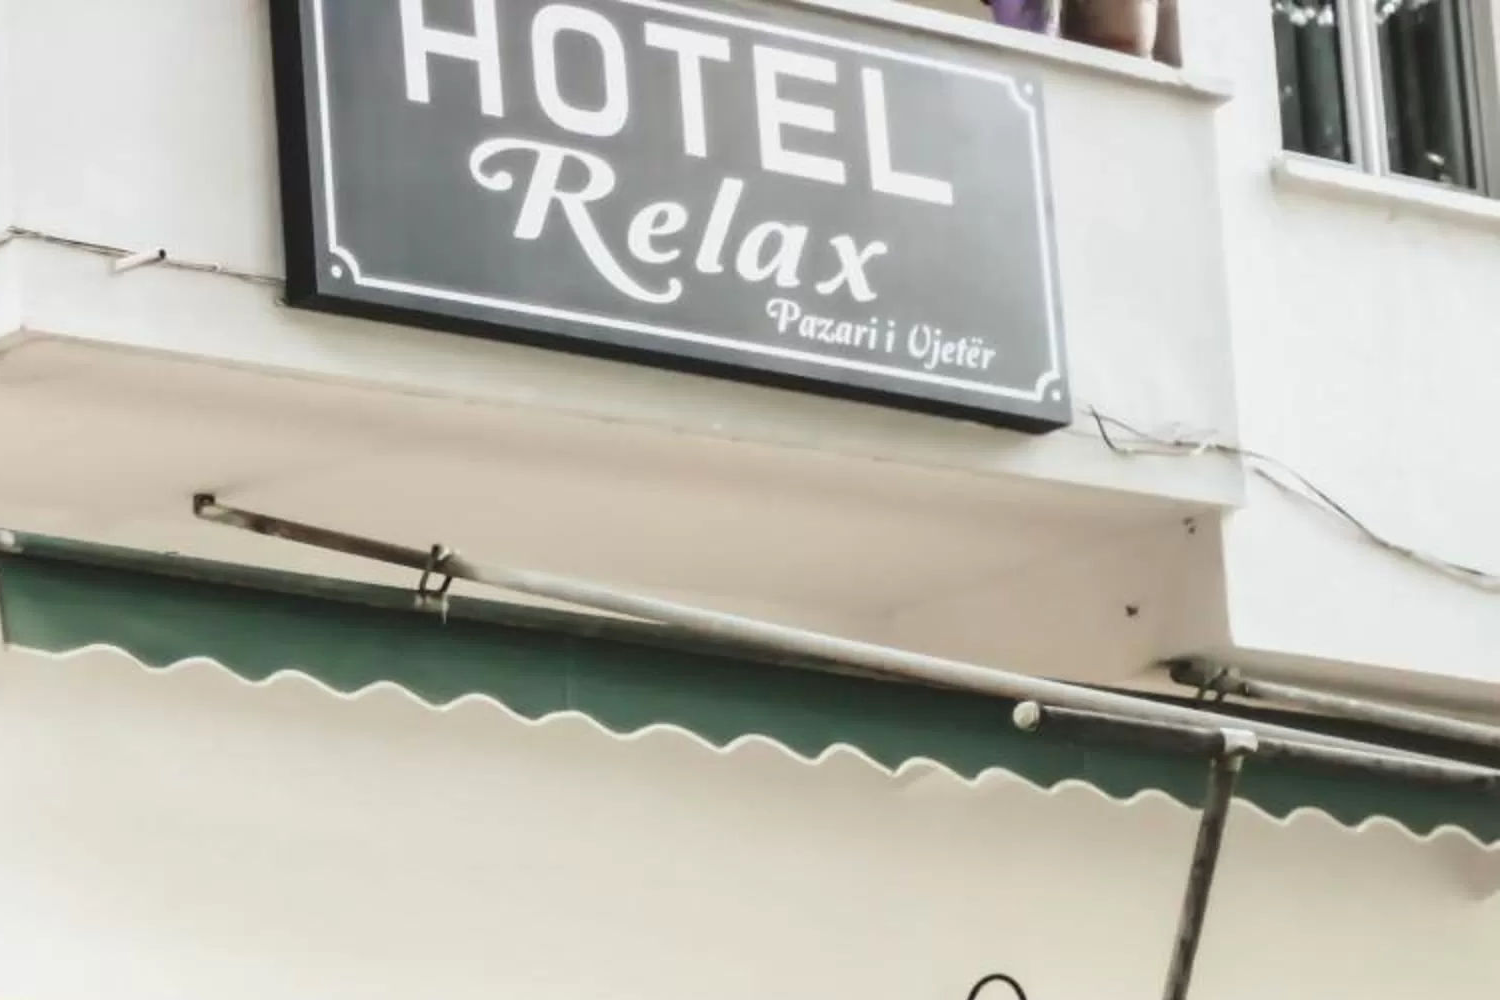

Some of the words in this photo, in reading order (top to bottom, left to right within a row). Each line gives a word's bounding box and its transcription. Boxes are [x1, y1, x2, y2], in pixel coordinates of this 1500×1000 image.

[400, 0, 953, 206] HOTEL
[468, 137, 888, 304] Relax
[765, 297, 879, 351] Pazari
[885, 319, 897, 353] i
